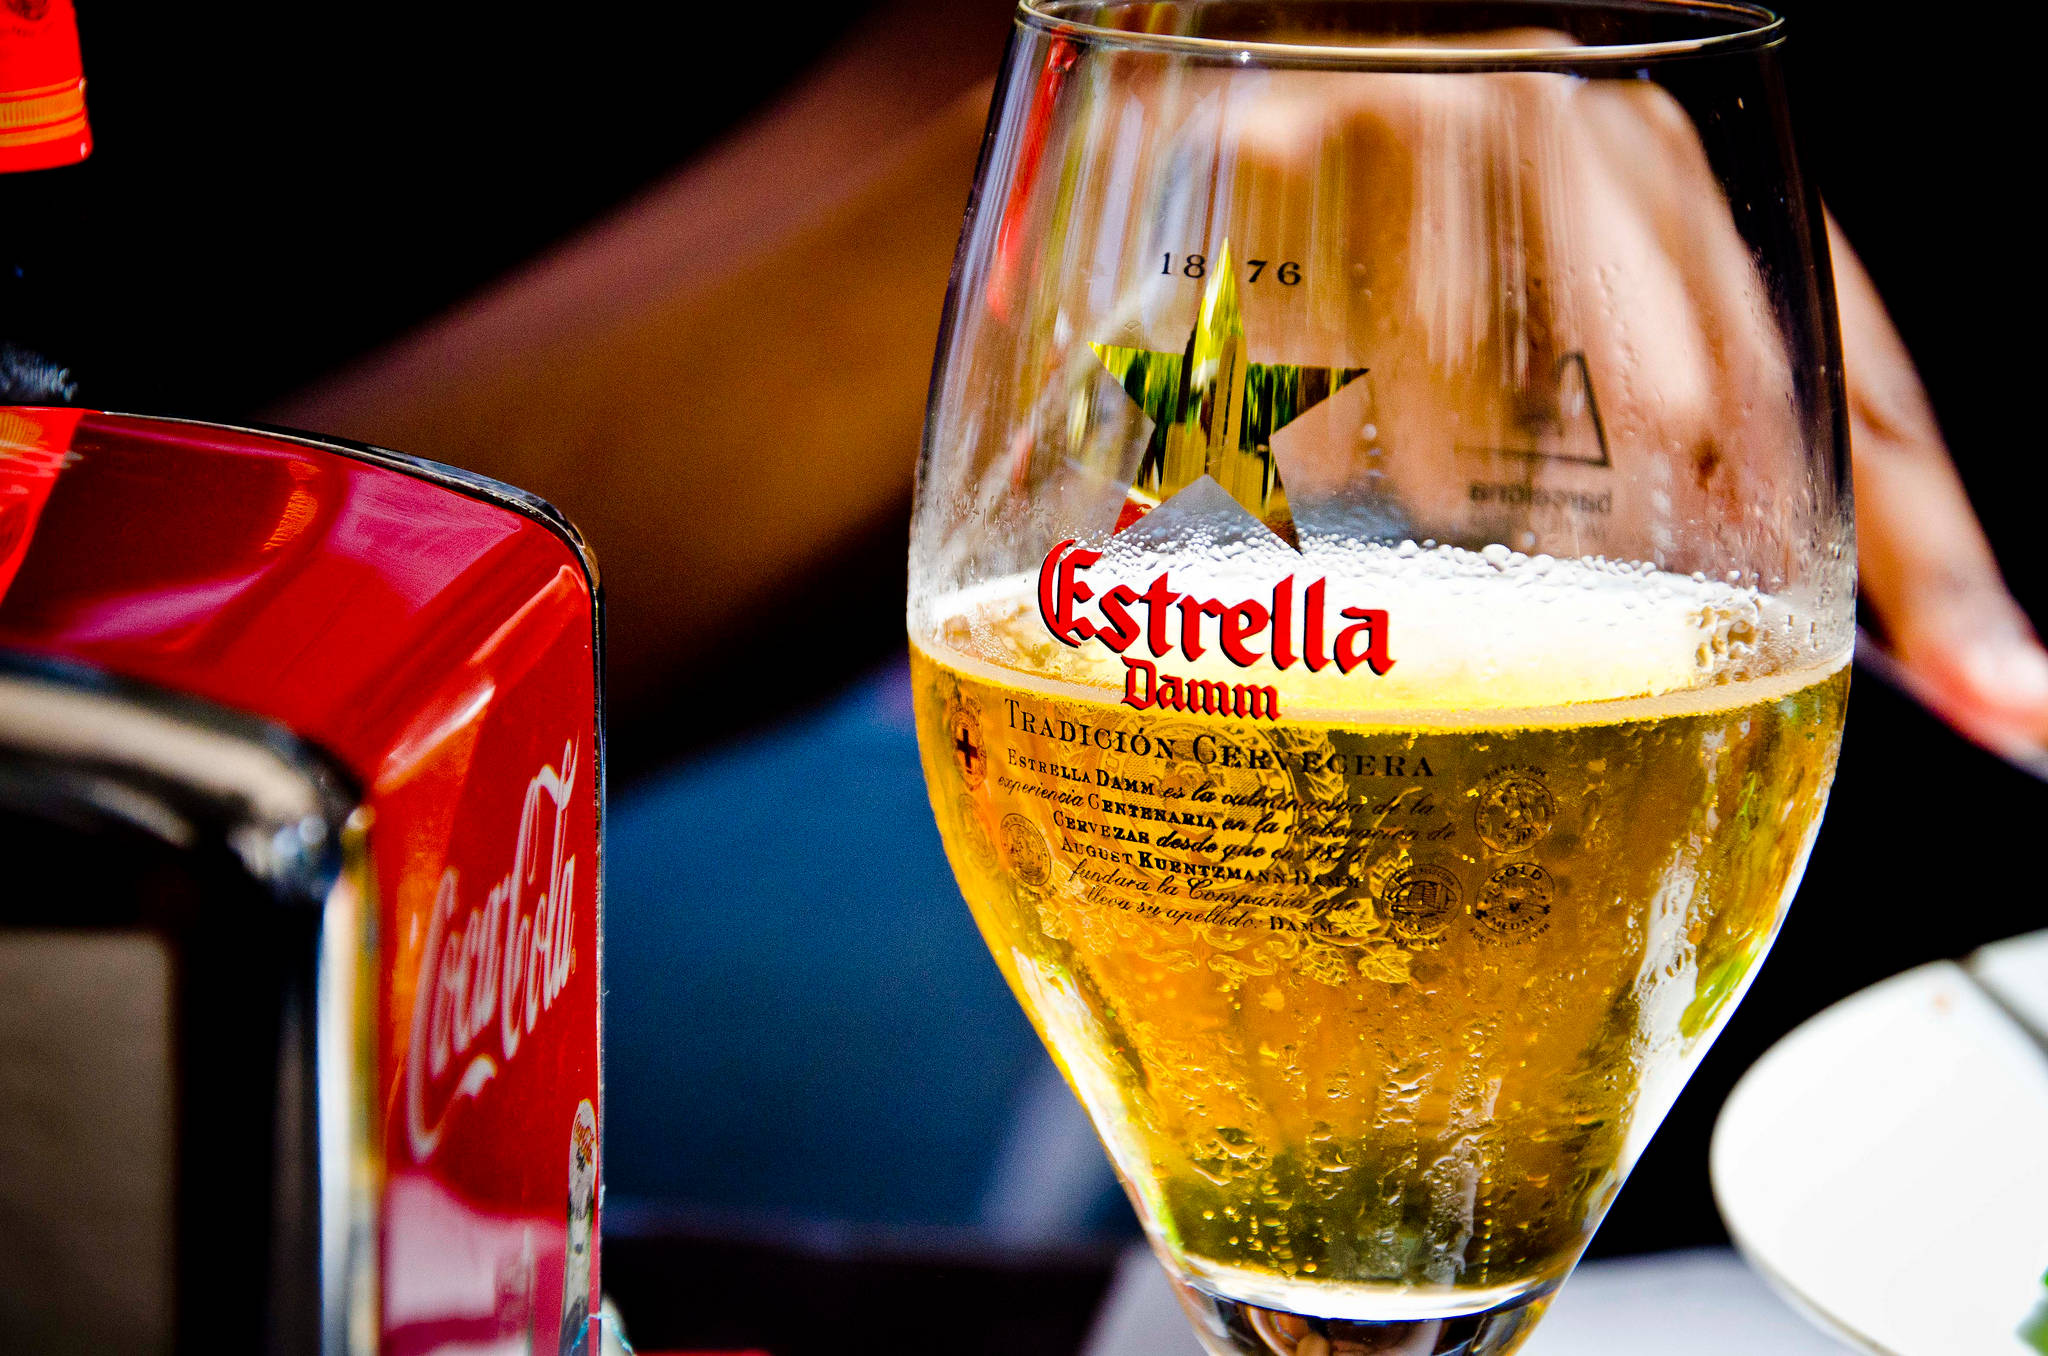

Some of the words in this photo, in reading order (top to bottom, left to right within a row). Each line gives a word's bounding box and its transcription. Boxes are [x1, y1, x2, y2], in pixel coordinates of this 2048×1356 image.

[1160, 252, 1206, 279] 18
[1247, 259, 1302, 286] 76
[1037, 538, 1398, 676] Estrella
[1120, 655, 1283, 722] Damm
[1005, 698, 1176, 760] TRADICIÓN
[1193, 734, 1434, 777] CERVECERA
[998, 776, 1084, 807] experiencia
[1087, 793, 1218, 830] CENTENARIA
[1221, 817, 1247, 831] en
[1252, 809, 1280, 834] la
[1427, 822, 1456, 841] de
[1007, 748, 1091, 783] ESTRELLA
[1096, 769, 1155, 795] DAMM
[1162, 785, 1186, 799] es
[1192, 780, 1216, 804] la
[1409, 792, 1435, 816] la
[1053, 810, 1150, 844] CERVEZAS
[1156, 830, 1218, 853] desde
[1220, 843, 1266, 862] que
[1061, 836, 1133, 865] AUGUST
[1137, 850, 1287, 885] KUENTZMANN
[1294, 870, 1361, 889] DAMM
[1069, 858, 1150, 892] fundara
[1157, 874, 1179, 896] la
[1311, 899, 1361, 916] que
[1491, 865, 1543, 884] GOLD
[1087, 884, 1132, 911] lleva
[1136, 901, 1161, 915] su
[1270, 915, 1334, 934] DAMM
